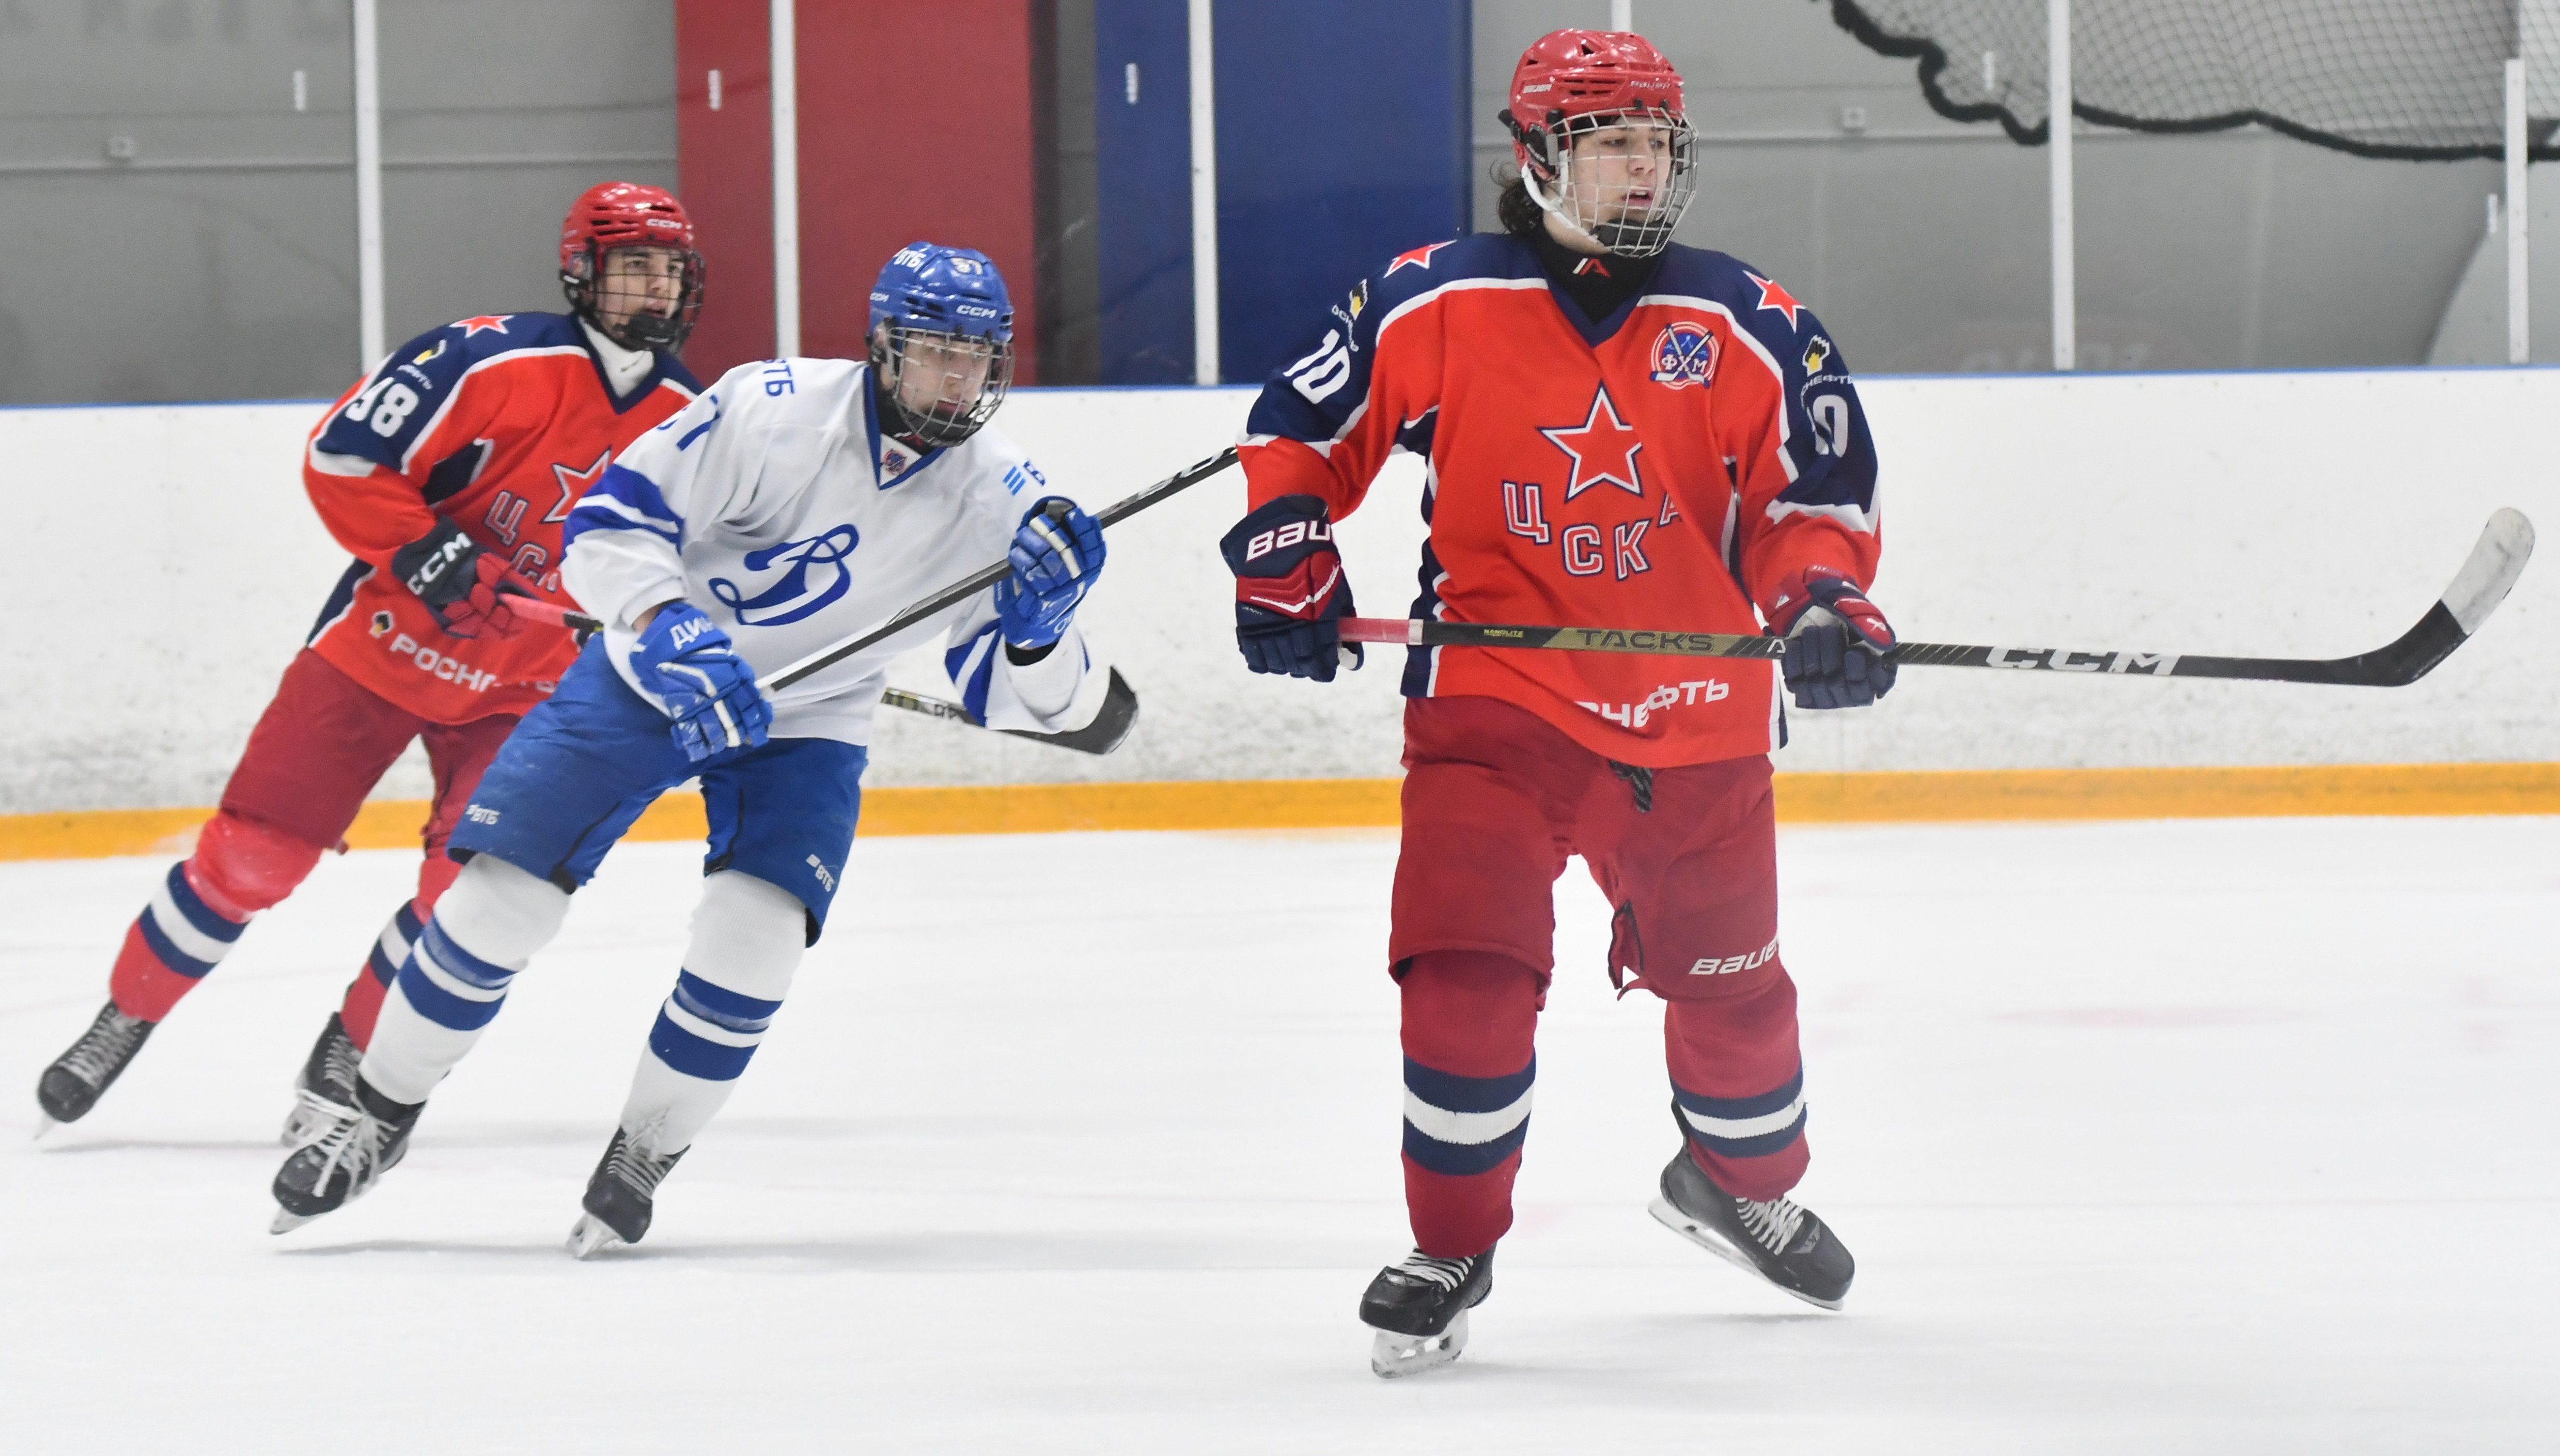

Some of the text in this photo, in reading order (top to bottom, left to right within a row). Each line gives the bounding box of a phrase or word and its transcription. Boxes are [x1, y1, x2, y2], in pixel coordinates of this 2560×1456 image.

[646, 218, 682, 230] CCM
[956, 305, 997, 319] CCM
[1661, 353, 1708, 373] ФХМ
[762, 359, 794, 397] ТБ
[407, 532, 472, 596] CCM
[1576, 629, 1714, 652] TACKS
[1986, 646, 2182, 676] CCM
[470, 808, 501, 825] ВТБ
[815, 864, 835, 893] ВТБ
